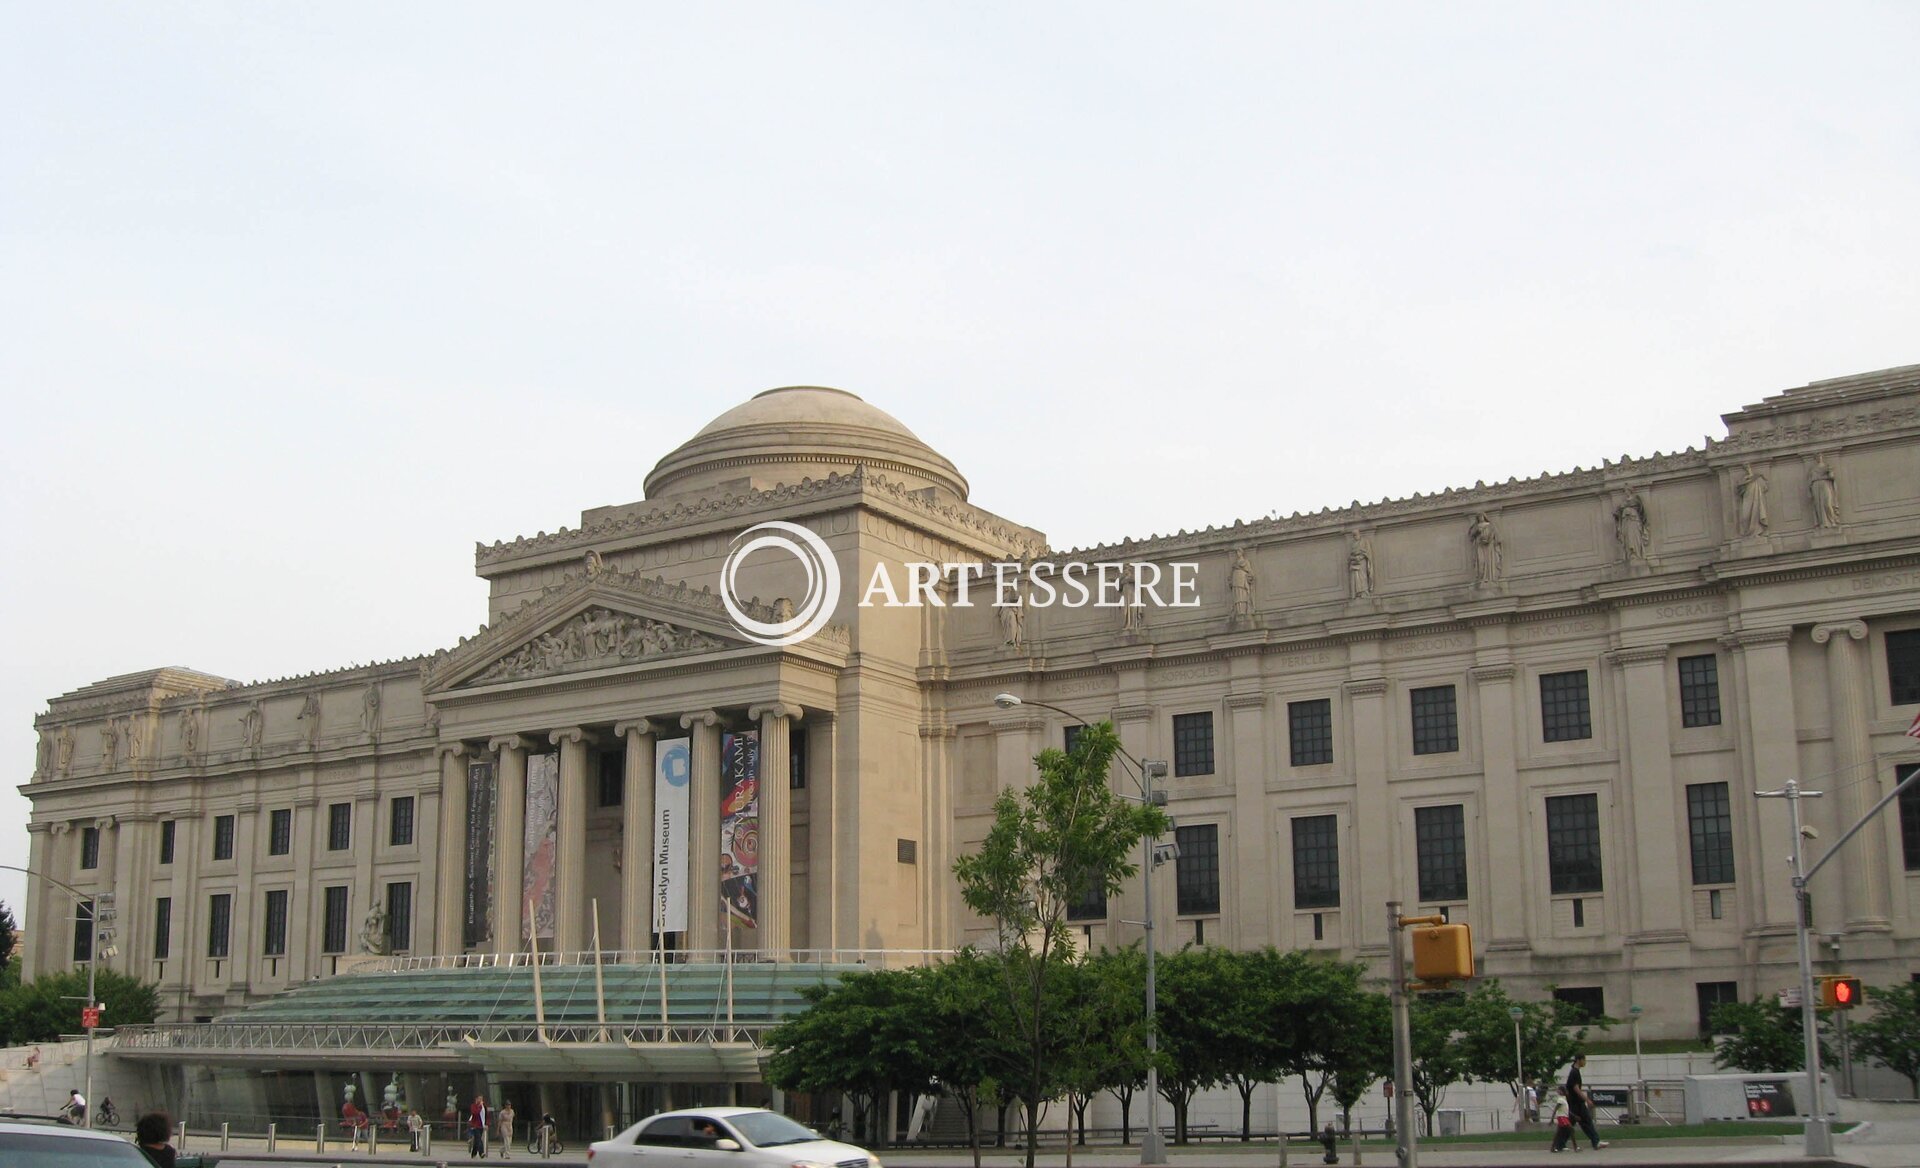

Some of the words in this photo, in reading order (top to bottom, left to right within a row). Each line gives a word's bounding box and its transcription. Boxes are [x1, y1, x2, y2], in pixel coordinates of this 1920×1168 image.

[1656, 602, 1727, 619] SOCRATES
[747, 748, 755, 767] July
[733, 737, 745, 826] MURAKAMI
[746, 770, 755, 806] through
[659, 809, 671, 865] Museum
[1592, 1092, 1616, 1103] Subway
